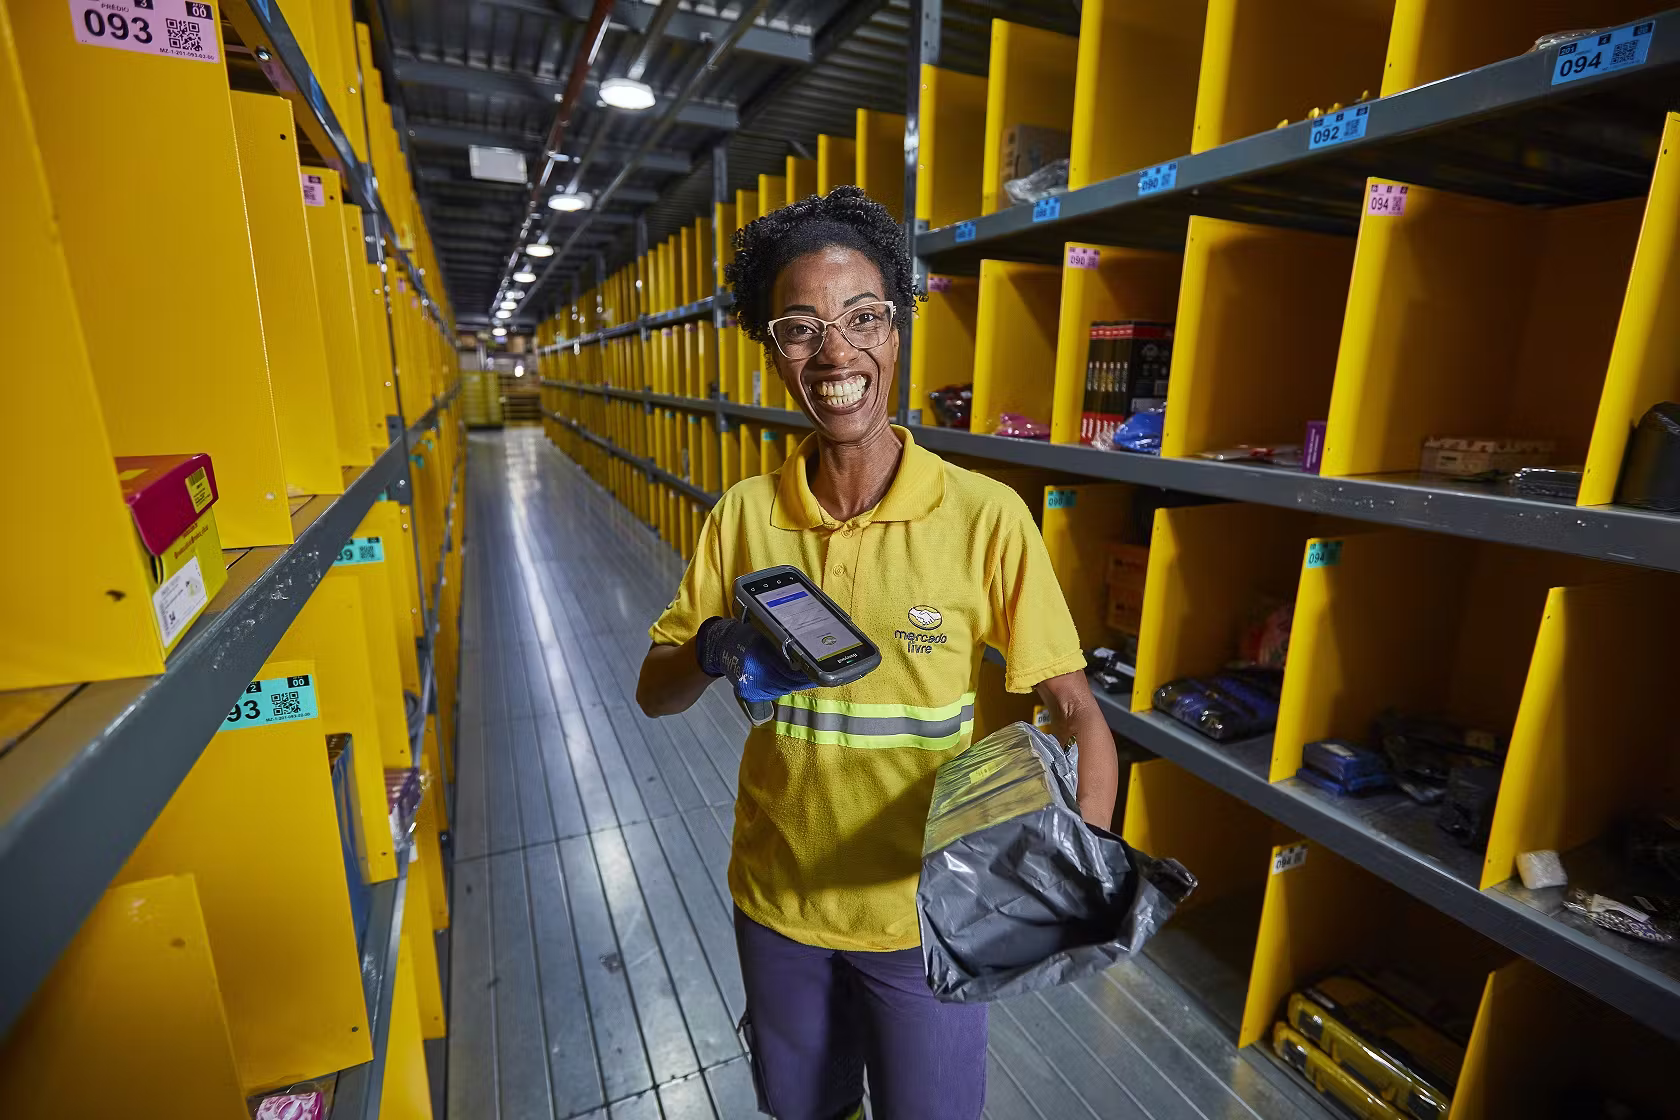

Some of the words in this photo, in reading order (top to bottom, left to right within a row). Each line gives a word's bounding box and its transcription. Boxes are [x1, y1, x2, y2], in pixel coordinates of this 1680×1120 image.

[101, 2, 130, 13] PRÉDIO
[192, 6, 207, 17] 00
[84, 9, 153, 44] 093
[1560, 52, 1602, 77] 094
[1313, 126, 1339, 144] 092
[1371, 197, 1389, 210] 094
[1070, 255, 1086, 265] 090
[338, 549, 353, 561] 9
[1308, 552, 1325, 564] 094
[894, 629, 948, 644] mercado
[907, 640, 933, 654] livre
[250, 684, 257, 692] 2
[292, 678, 305, 687] 00
[1276, 855, 1292, 869] 094
